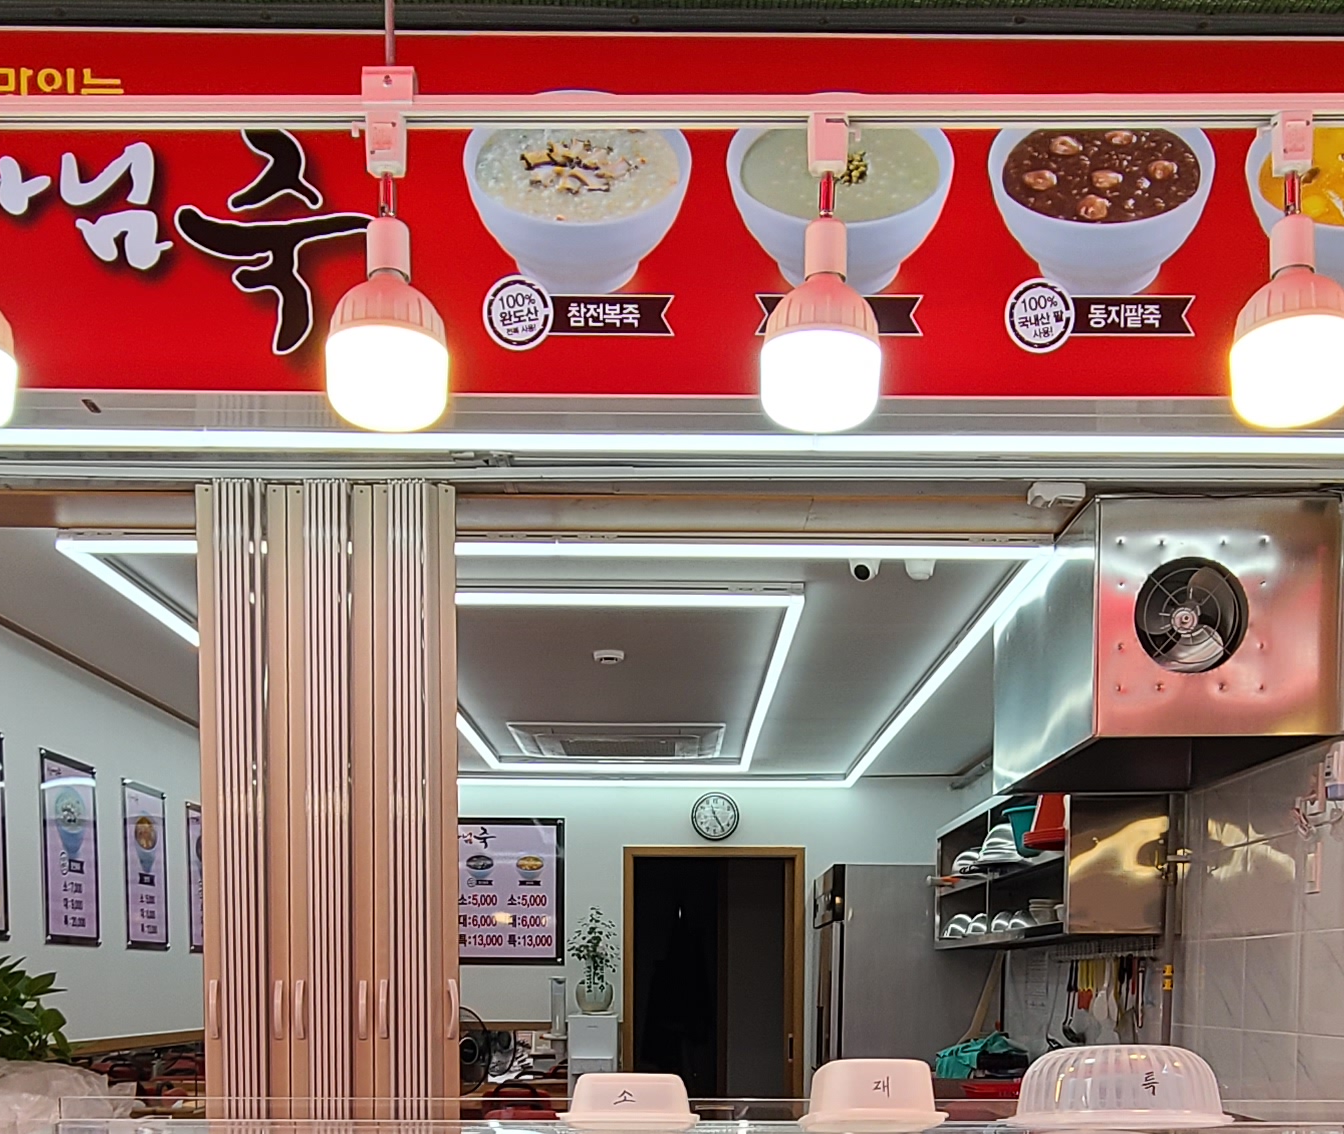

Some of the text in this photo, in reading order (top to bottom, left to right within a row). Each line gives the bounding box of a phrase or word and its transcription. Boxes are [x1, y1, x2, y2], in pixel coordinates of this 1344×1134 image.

[499, 293, 536, 310] 100%
[1021, 295, 1057, 313] 100%
[499, 306, 539, 327] 완도산
[567, 302, 641, 328] 참전복죽
[1018, 313, 1050, 329] 국내산
[1088, 304, 1162, 328] 동지팥죽
[614, 1089, 636, 1106] 소
